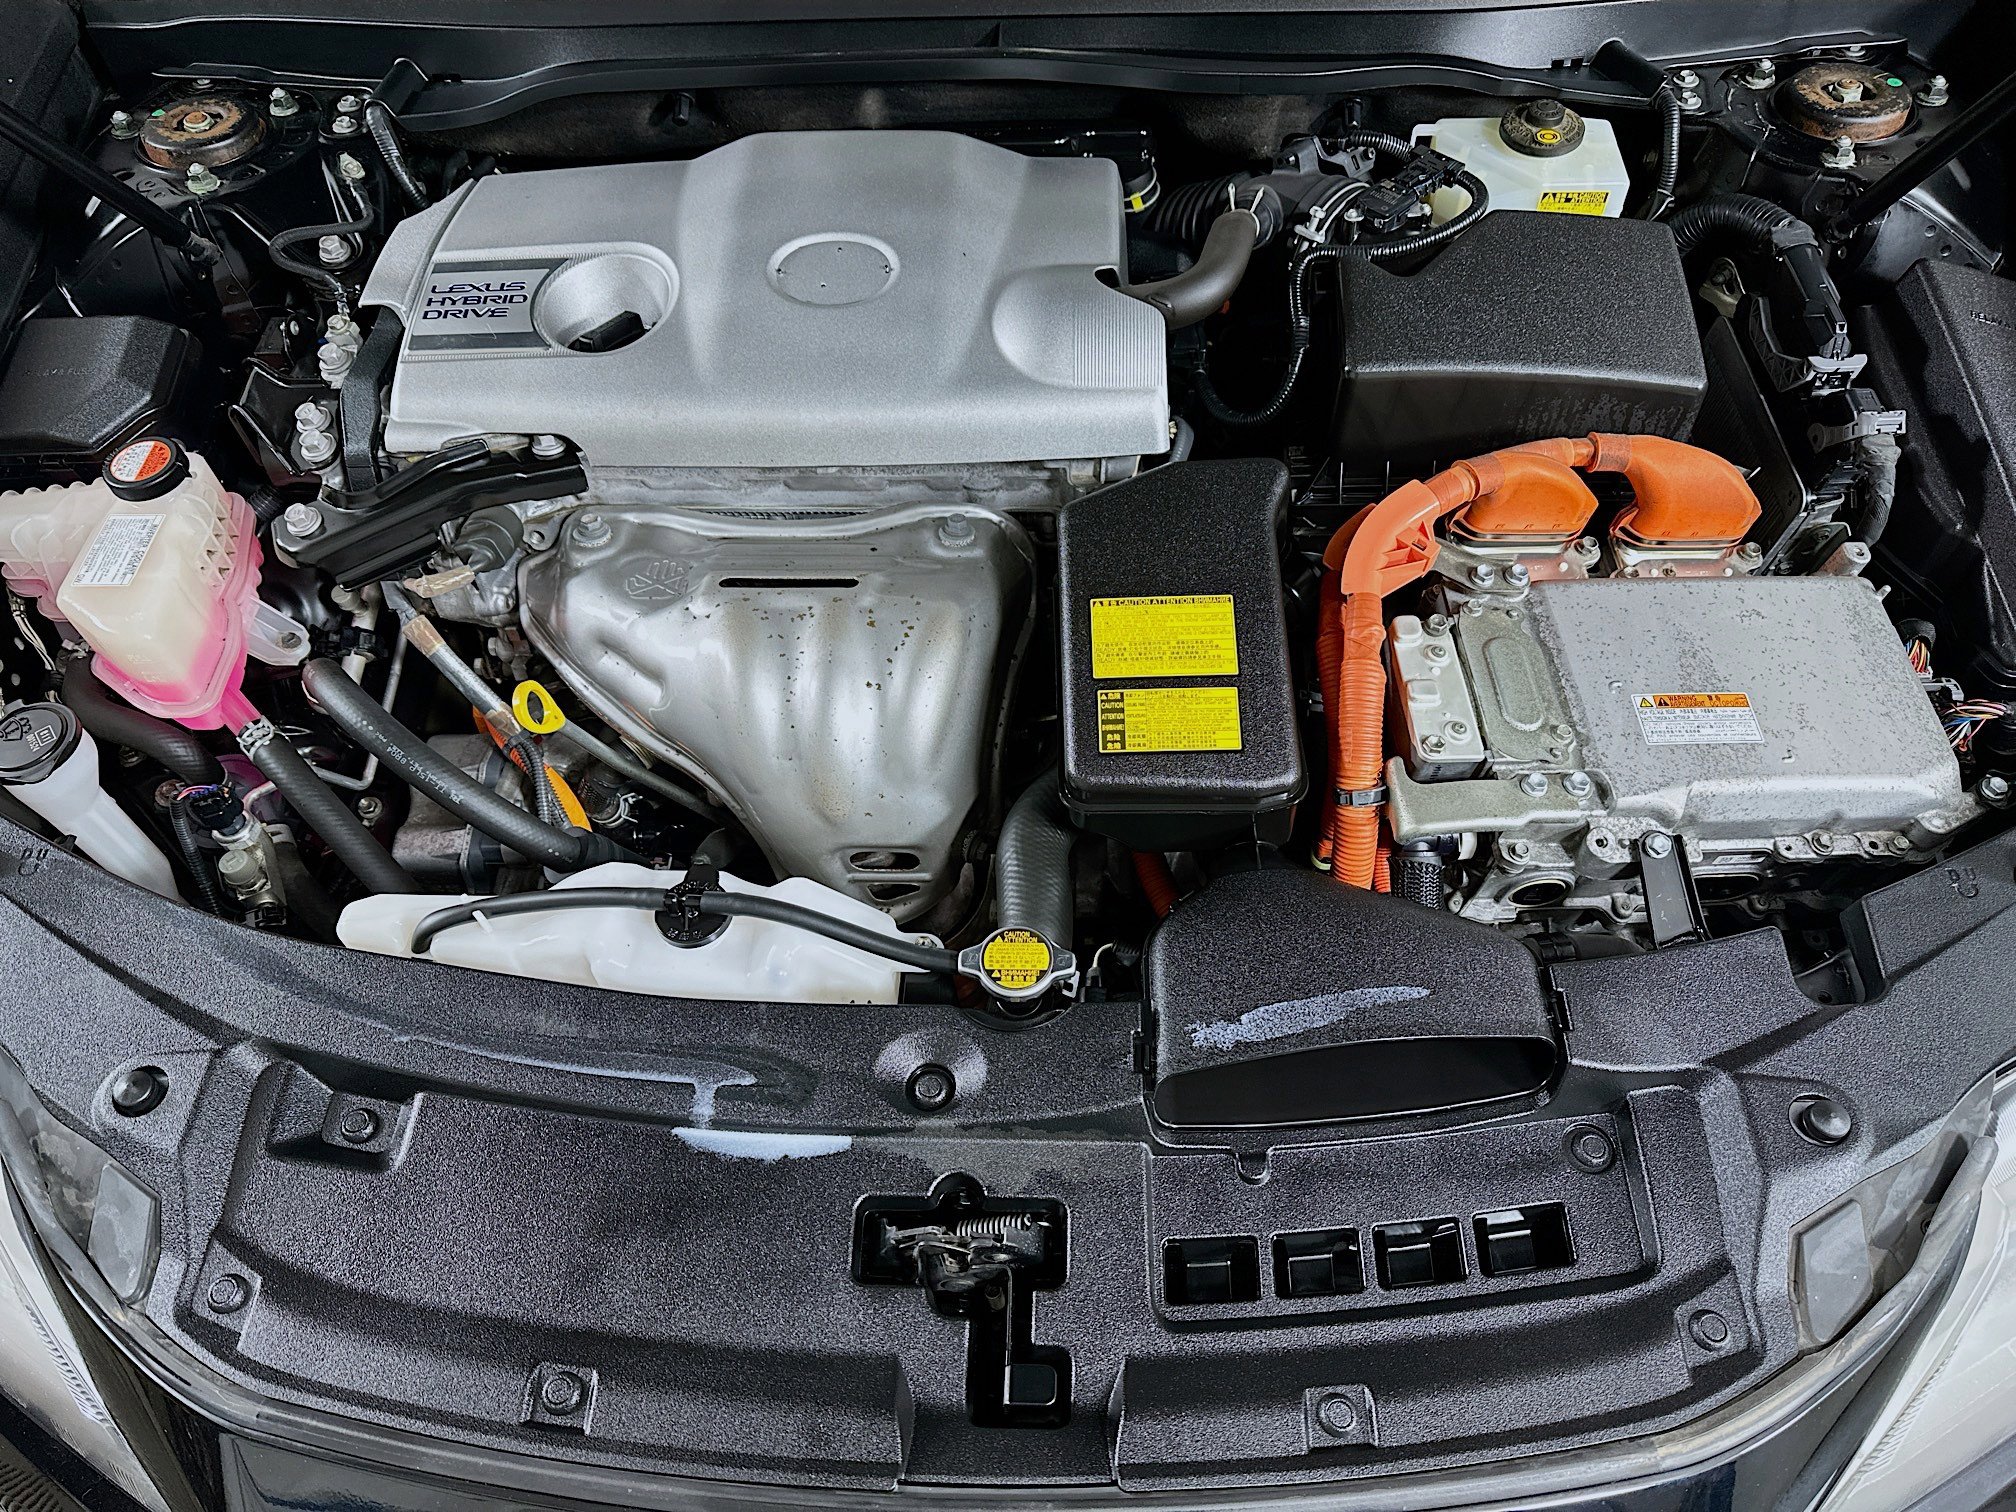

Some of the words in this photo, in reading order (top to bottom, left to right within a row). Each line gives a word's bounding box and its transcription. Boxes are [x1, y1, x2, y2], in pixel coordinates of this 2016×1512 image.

[431, 281, 526, 294] LEXUS
[426, 294, 529, 307] HYBRID
[422, 307, 510, 320] DRIVE
[1119, 598, 1151, 606] CAUTION
[1152, 597, 1193, 605] ATTENTION
[1101, 701, 1124, 709] CAUTION
[1101, 712, 1124, 720] ATTENTION
[1001, 969, 1040, 977] ВНИМАНИЕ!
